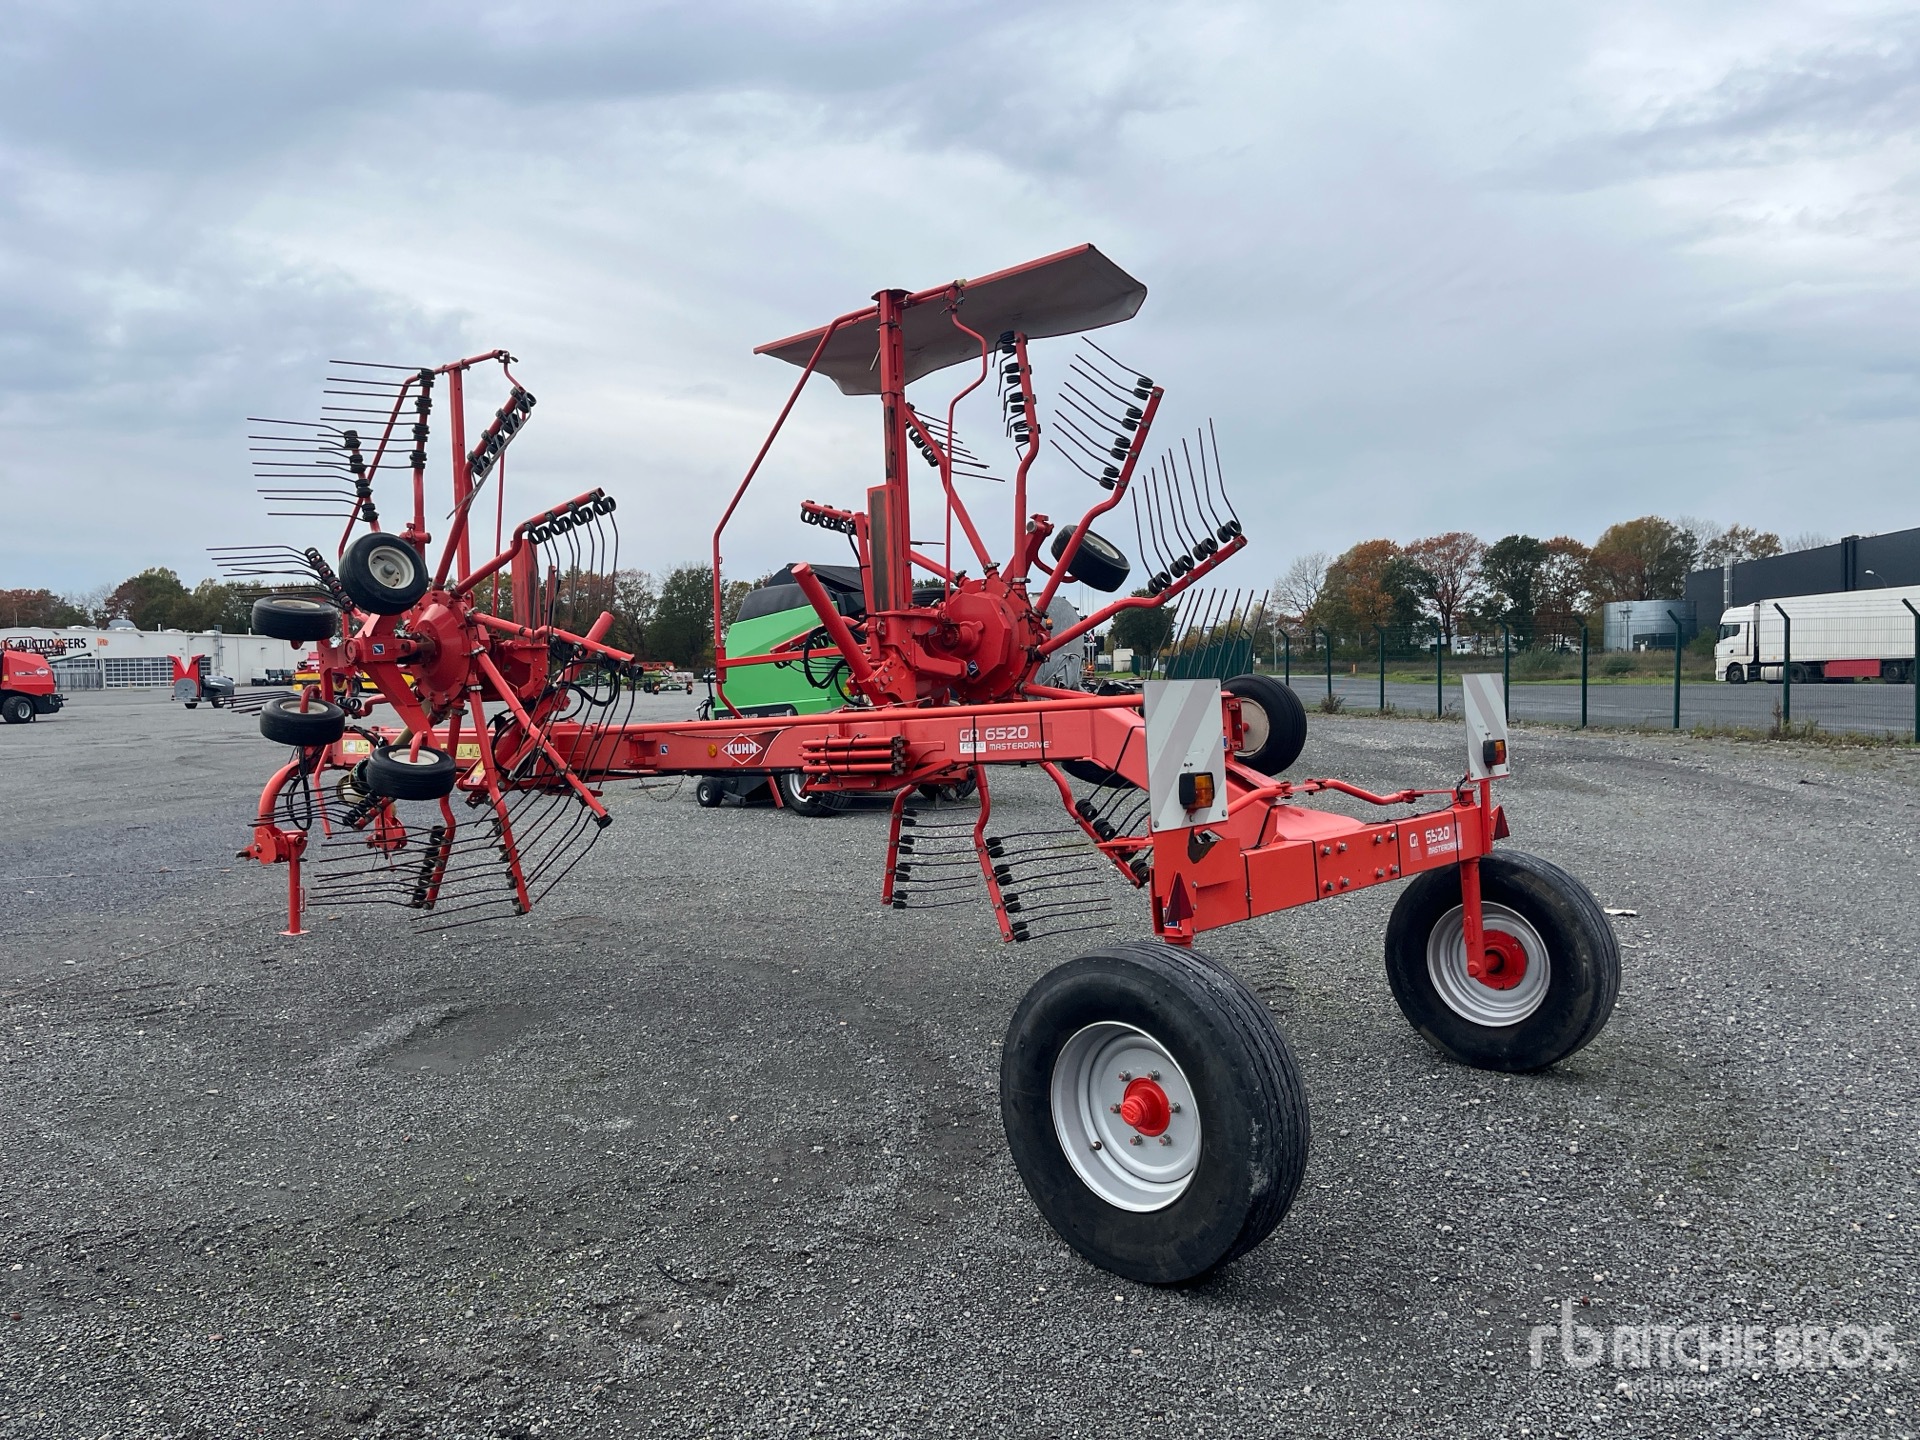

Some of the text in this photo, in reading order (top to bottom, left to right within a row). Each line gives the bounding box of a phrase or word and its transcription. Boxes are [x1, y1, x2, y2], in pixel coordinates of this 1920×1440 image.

[960, 725, 1029, 742] GA 6520
[727, 743, 757, 755] KUHN
